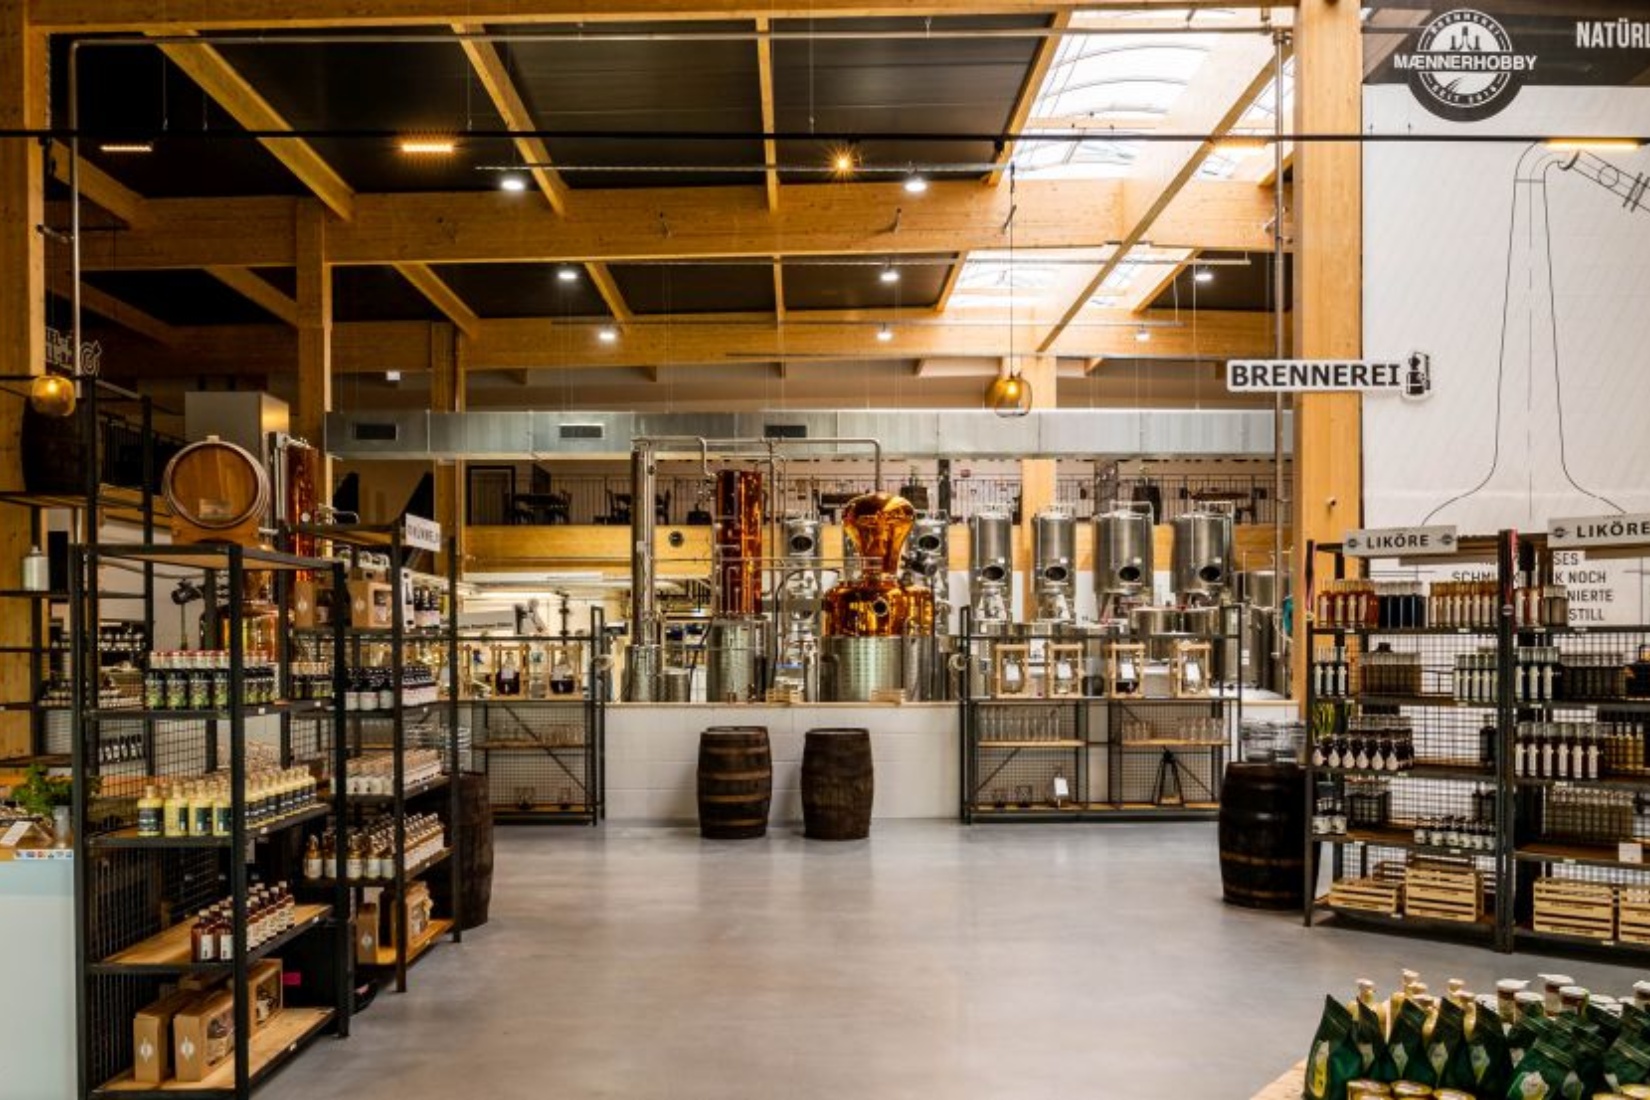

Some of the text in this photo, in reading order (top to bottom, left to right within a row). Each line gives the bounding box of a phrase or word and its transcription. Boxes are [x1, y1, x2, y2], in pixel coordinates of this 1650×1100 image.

[1393, 54, 1537, 70] MÆNNERHOBBY
[1231, 364, 1400, 387] BRENNEREI
[1576, 521, 1650, 538] LIKÖRE
[1366, 533, 1430, 549] LIKÖRE
[1568, 571, 1606, 584] NOCH
